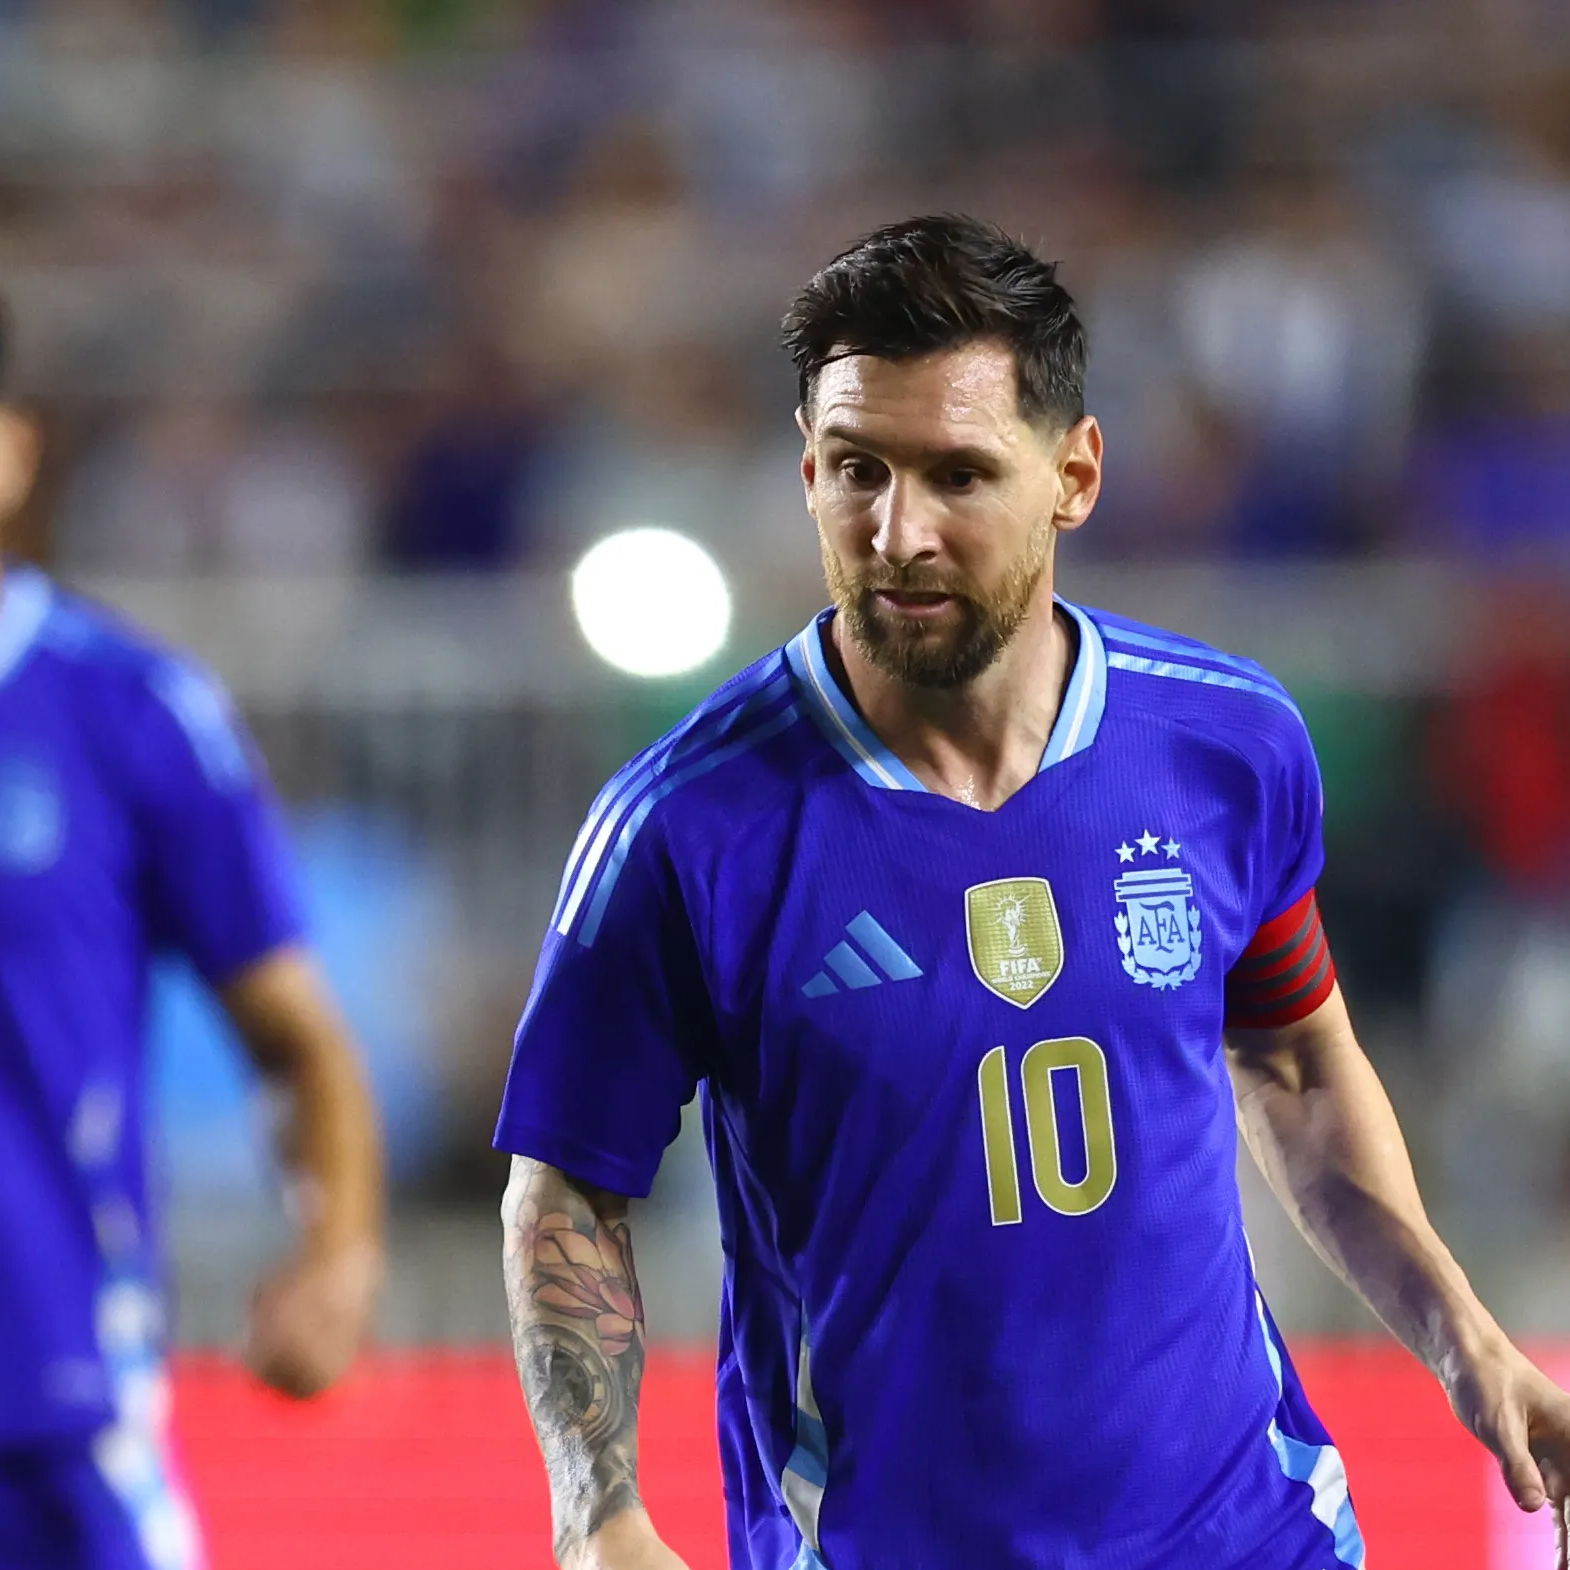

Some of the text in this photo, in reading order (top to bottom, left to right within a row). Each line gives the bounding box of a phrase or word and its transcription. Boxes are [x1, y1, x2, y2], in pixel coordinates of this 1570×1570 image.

[1137, 900, 1186, 954] AFA
[999, 957, 1041, 977] FIFA
[1009, 980, 1034, 991] 2022
[977, 1036, 1118, 1227] 10
